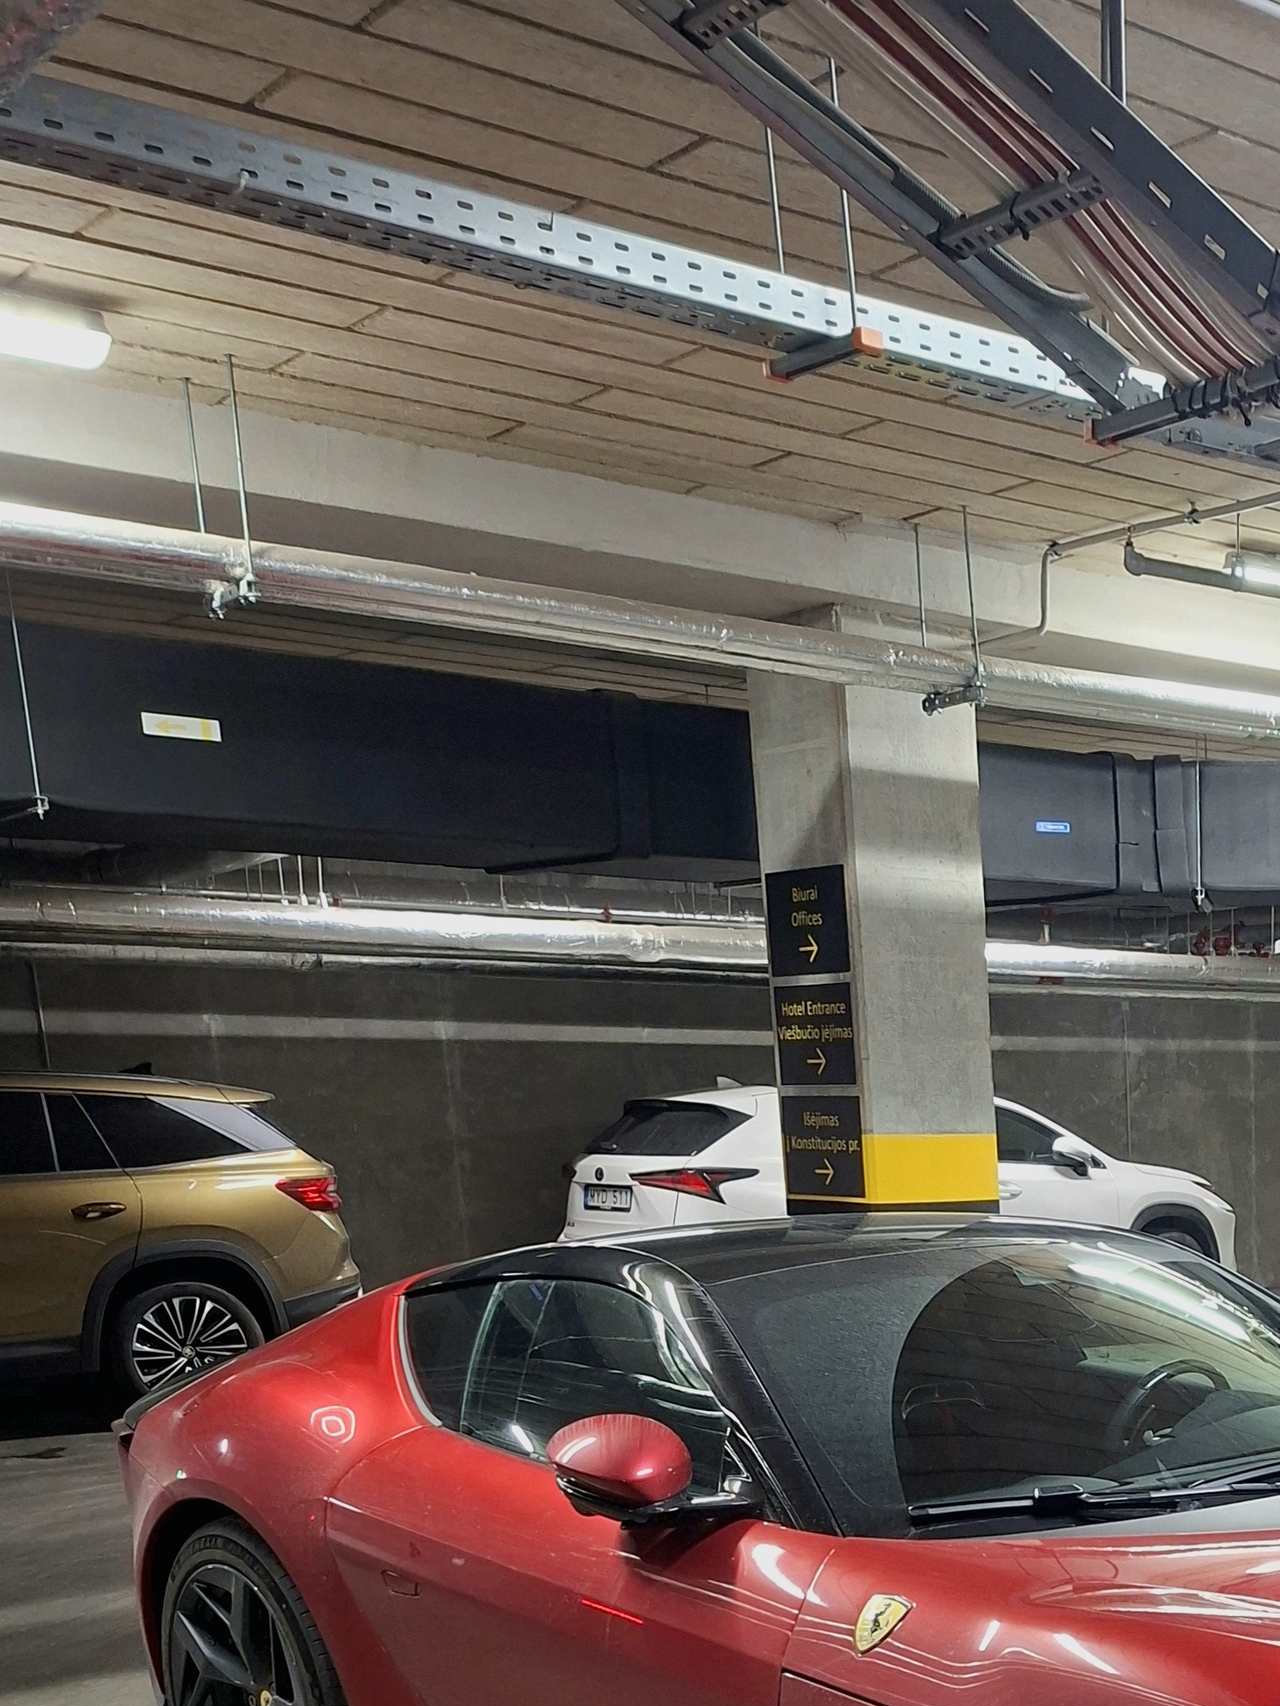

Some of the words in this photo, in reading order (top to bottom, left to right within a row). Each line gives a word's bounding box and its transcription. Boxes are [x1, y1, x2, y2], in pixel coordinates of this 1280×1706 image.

[792, 885, 818, 902] Biurai
[791, 911, 823, 927] Offices
[781, 1001, 805, 1016] Hotel
[806, 1001, 846, 1016] Entrance
[778, 1024, 820, 1040] Viešbučio
[791, 1135, 847, 1153] Konstitucijos
[848, 1140, 860, 1154] pr.
